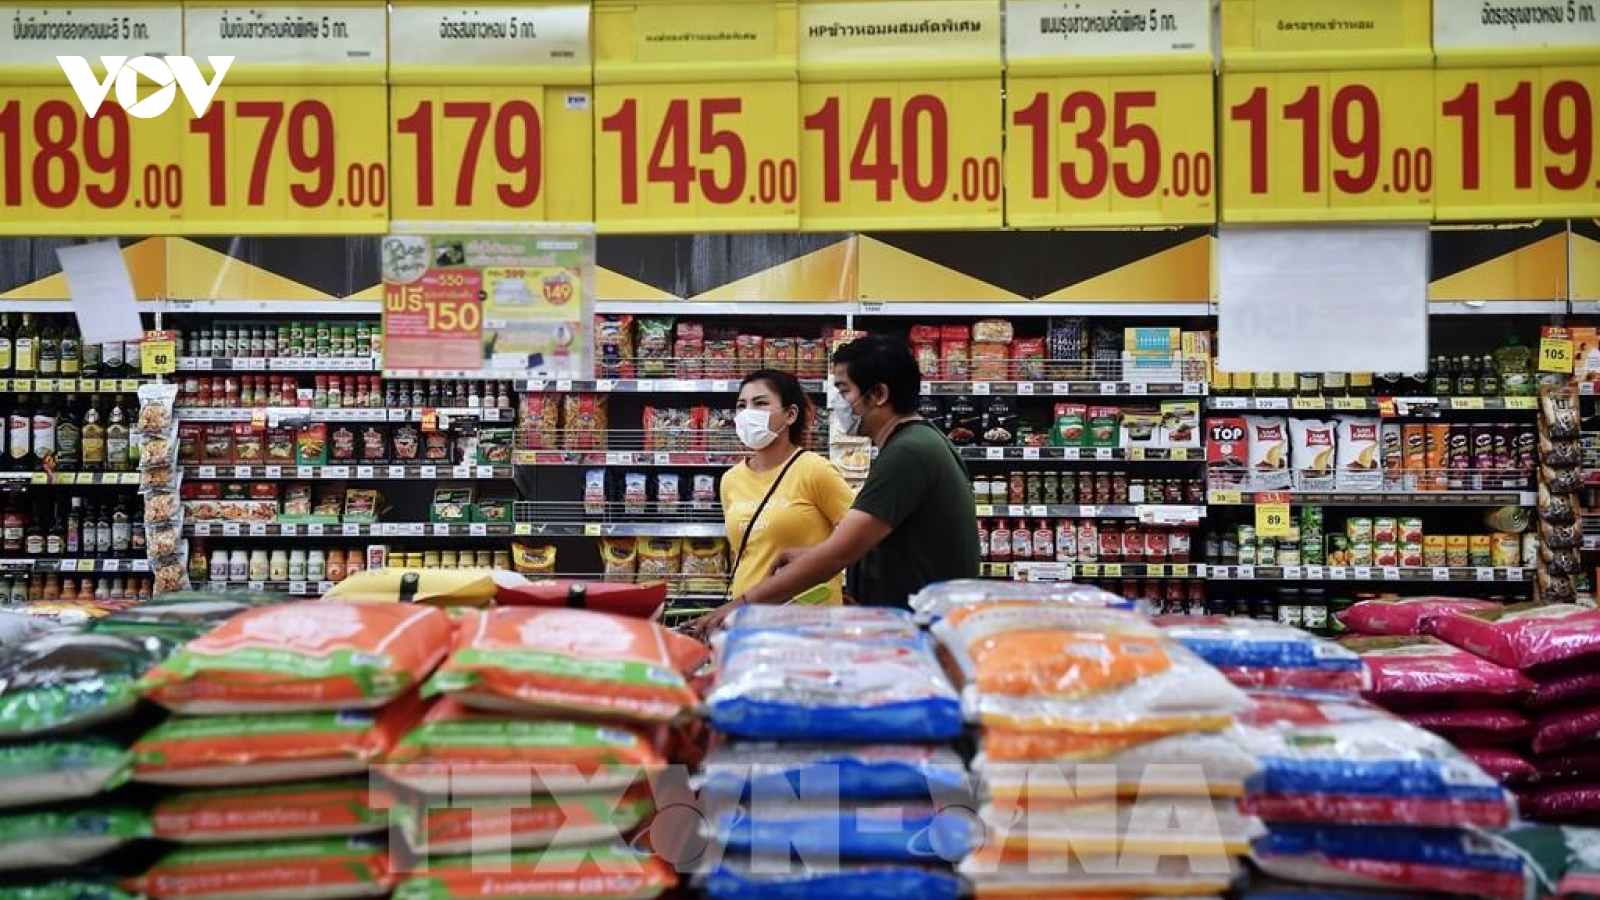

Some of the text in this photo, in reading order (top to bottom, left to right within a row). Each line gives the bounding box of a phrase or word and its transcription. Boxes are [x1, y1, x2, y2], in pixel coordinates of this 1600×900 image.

[1149, 9, 1157, 32] 5
[1567, 0, 1575, 23] 5
[122, 17, 130, 39] 5
[322, 16, 330, 38] 5
[510, 16, 517, 39] 5
[602, 97, 797, 204] 145.00
[804, 94, 1000, 203] 140.00
[1013, 90, 1211, 199] 135.00
[1230, 84, 1432, 194] 119.00
[0, 100, 182, 209] 189.00
[190, 99, 385, 208] 179.00
[397, 100, 542, 209] 179
[387, 285, 424, 312] ฟรี
[544, 284, 571, 301] 149
[425, 302, 480, 331] 150
[154, 355, 167, 365] 60
[1544, 348, 1565, 360] 105
[1213, 428, 1243, 441] TOP
[1267, 514, 1281, 524] 89
